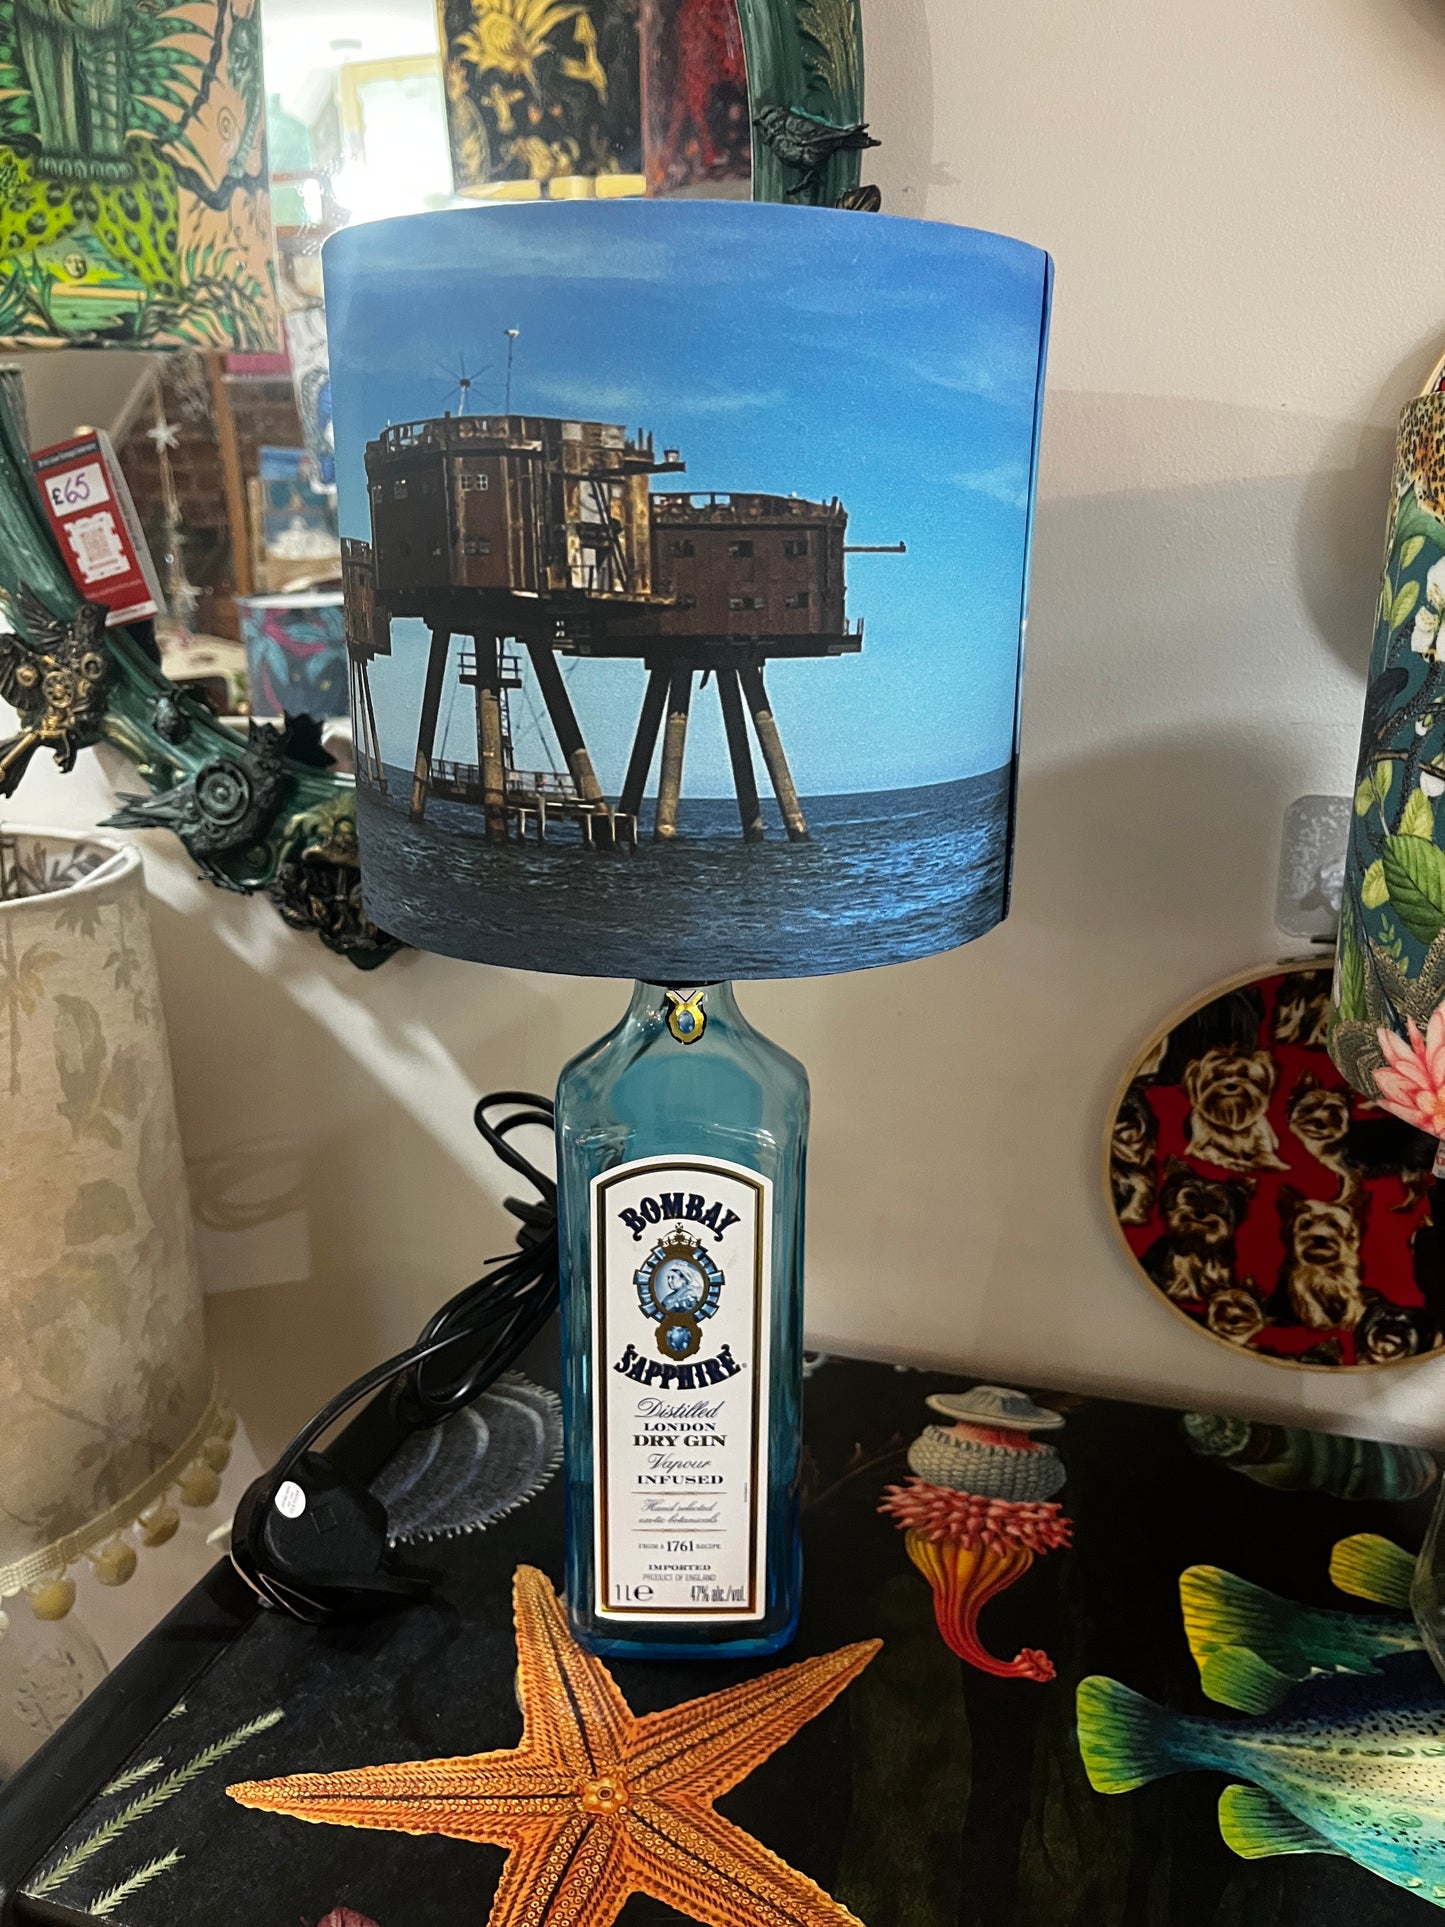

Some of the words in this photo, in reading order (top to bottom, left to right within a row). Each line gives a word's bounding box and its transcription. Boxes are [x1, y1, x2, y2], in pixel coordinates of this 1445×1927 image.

[52, 472, 91, 506] £65
[618, 1192, 742, 1242] BOMBAY
[613, 1344, 742, 1390] SAPPHIRE
[634, 1397, 725, 1419] Distilled
[644, 1423, 716, 1431] LONDON
[632, 1435, 679, 1447] DRY
[683, 1435, 727, 1447] GIN
[647, 1453, 712, 1474] Vapour
[637, 1475, 724, 1485] INFUSED
[667, 1540, 694, 1552] 1761
[691, 1585, 710, 1602] 47%
